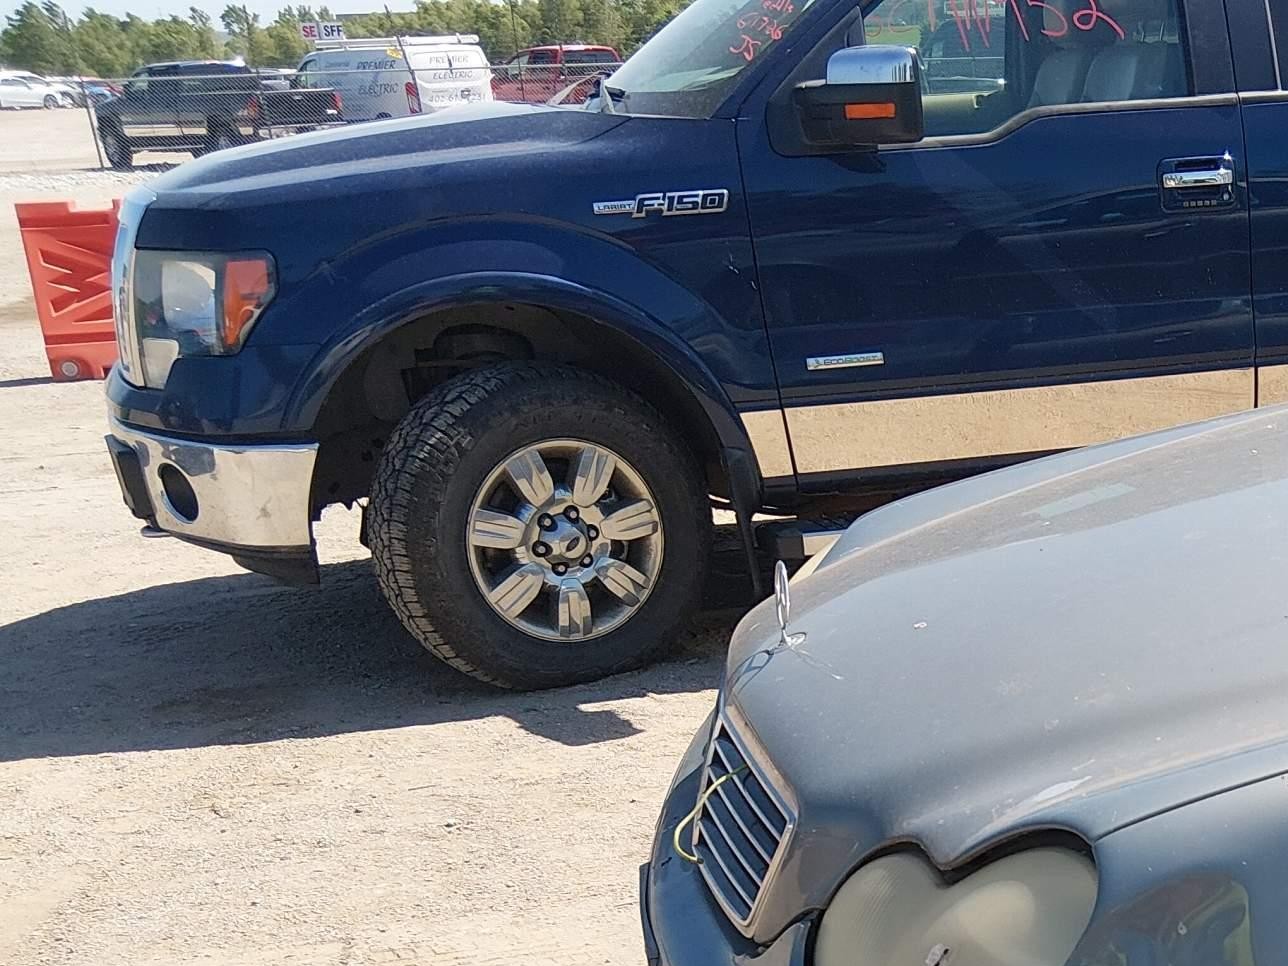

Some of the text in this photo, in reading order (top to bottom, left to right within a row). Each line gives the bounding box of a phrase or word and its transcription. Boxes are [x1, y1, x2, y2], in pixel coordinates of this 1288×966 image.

[357, 60, 396, 69] PREMIER
[433, 70, 473, 80] ELECTRIC
[597, 190, 728, 217] LARIAT F-150
